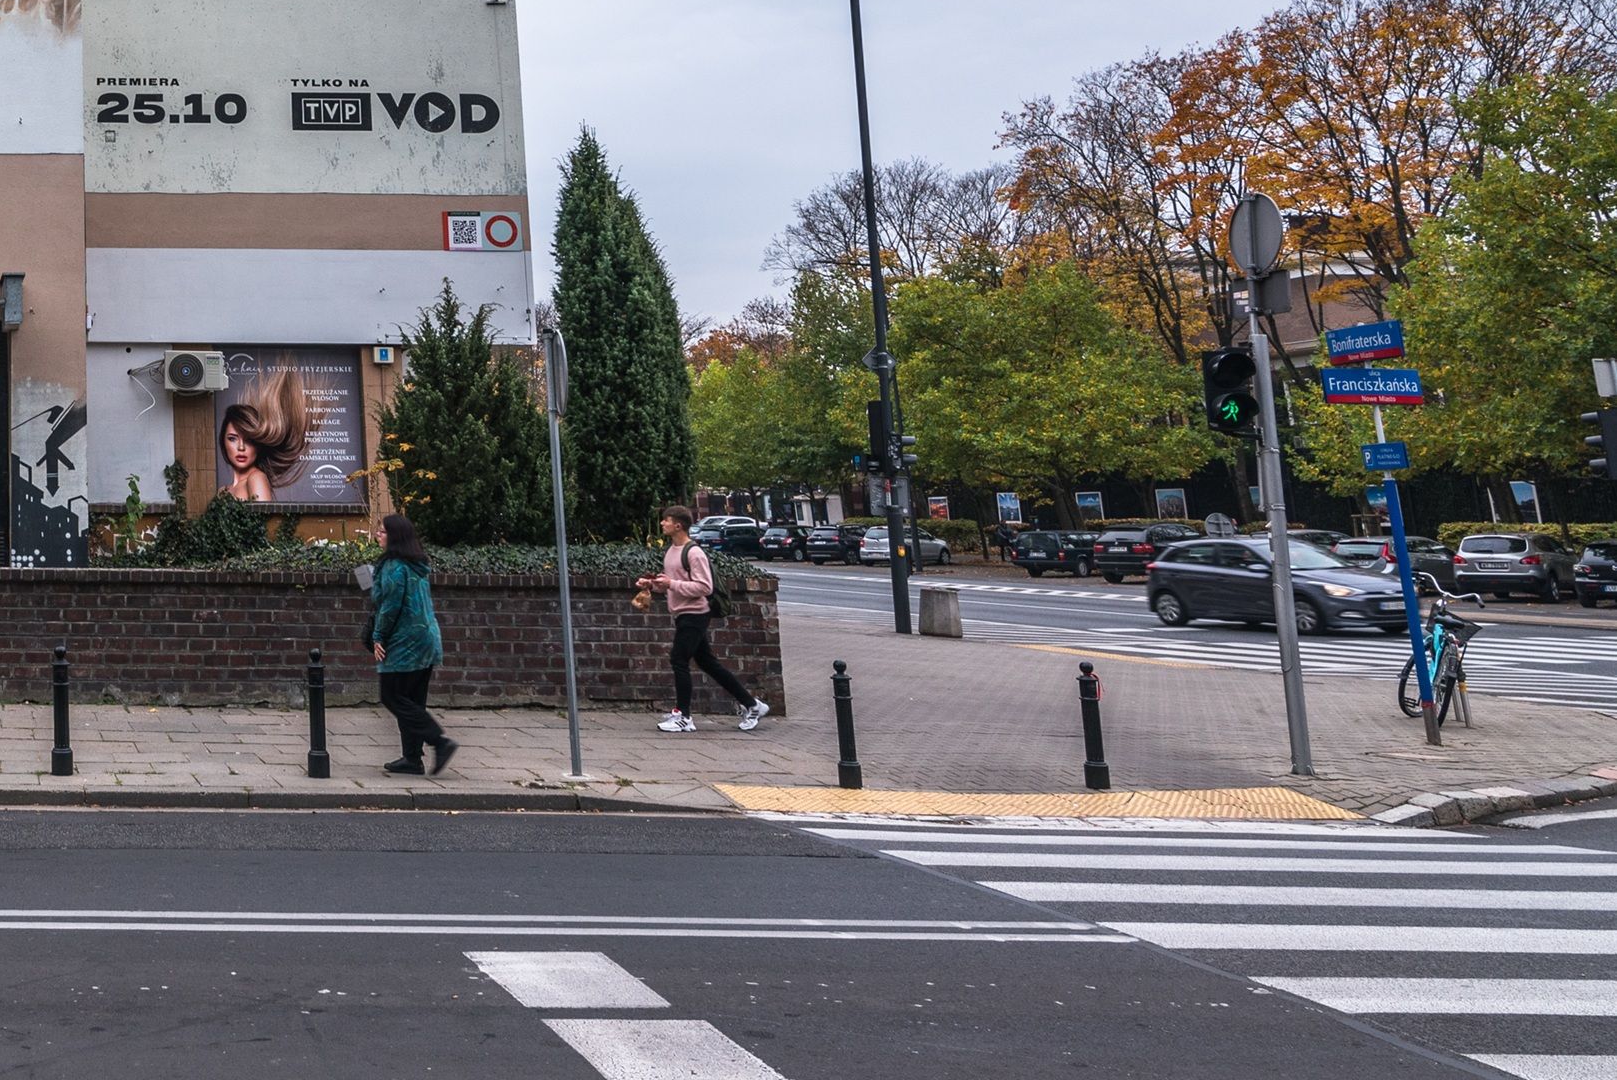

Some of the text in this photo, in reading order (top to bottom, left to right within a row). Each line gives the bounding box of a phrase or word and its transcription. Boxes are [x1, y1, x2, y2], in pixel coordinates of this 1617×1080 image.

[96, 77, 180, 87] PREMIERA
[291, 78, 370, 88] TYLKO NA
[96, 92, 248, 125] 25.10
[302, 91, 501, 134] TVP VOD
[1331, 331, 1392, 353] Bonifraterska
[1328, 377, 1418, 393] Franciszkańska
[1364, 452, 1371, 464] P
